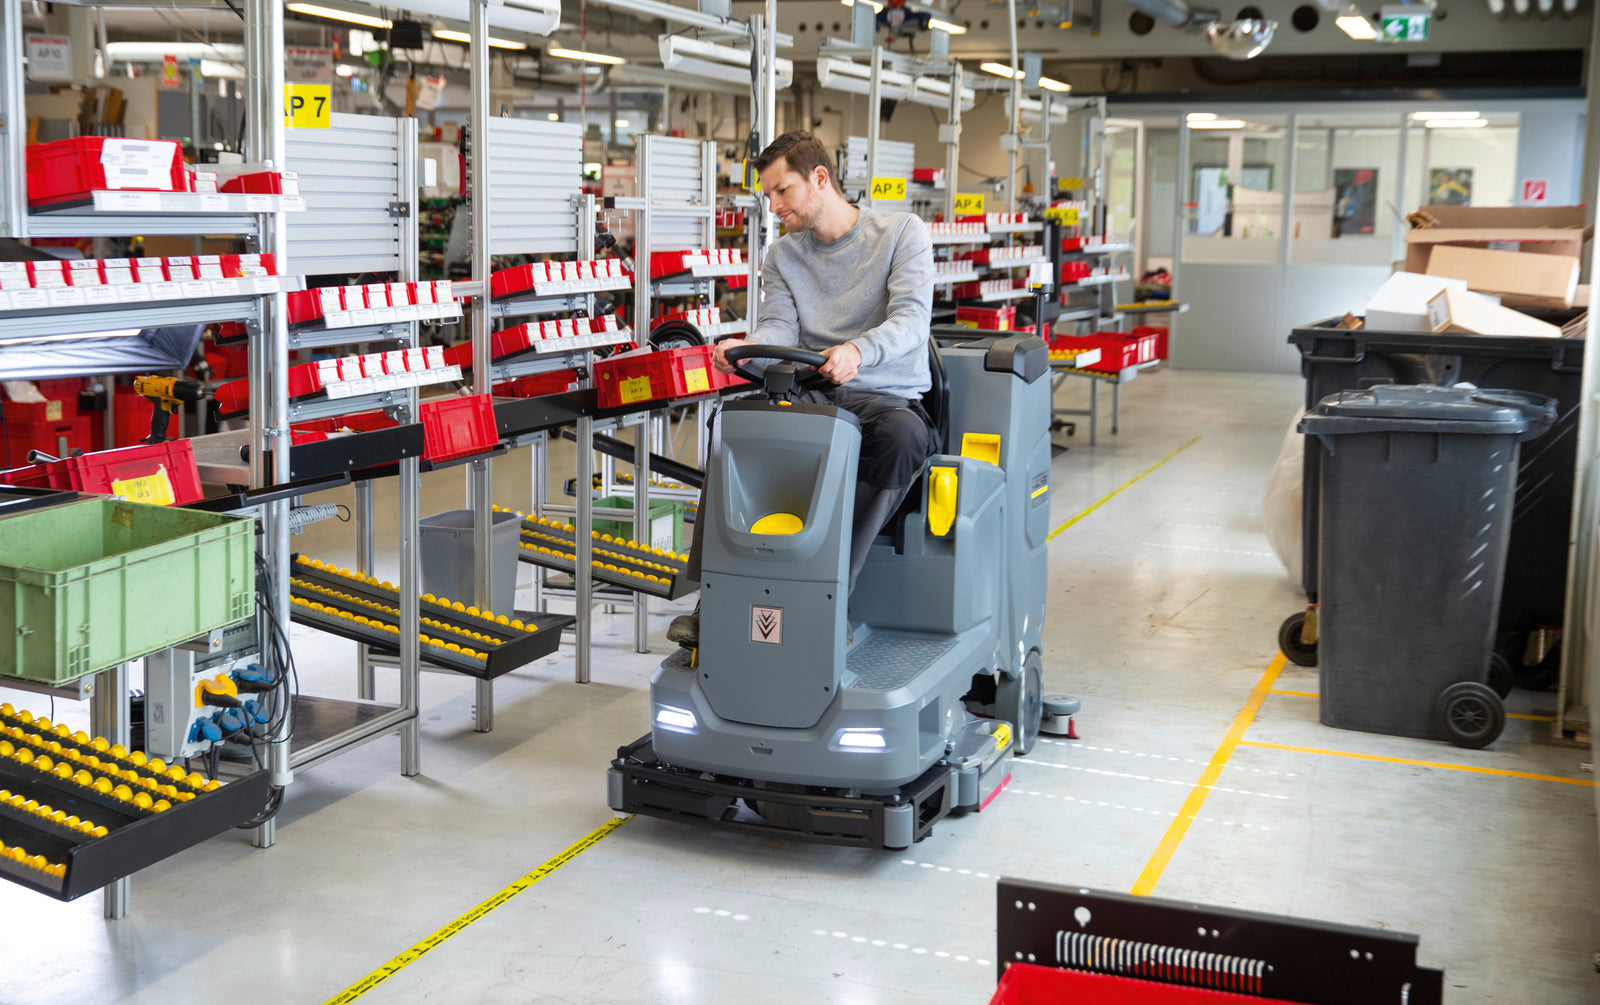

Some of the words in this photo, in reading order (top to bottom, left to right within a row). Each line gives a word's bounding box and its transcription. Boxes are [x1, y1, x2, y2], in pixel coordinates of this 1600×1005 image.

[284, 96, 304, 117] P
[313, 96, 326, 118] 7
[873, 183, 892, 194] AP
[897, 183, 904, 195] 5
[955, 199, 972, 209] AP
[975, 199, 982, 209] 4
